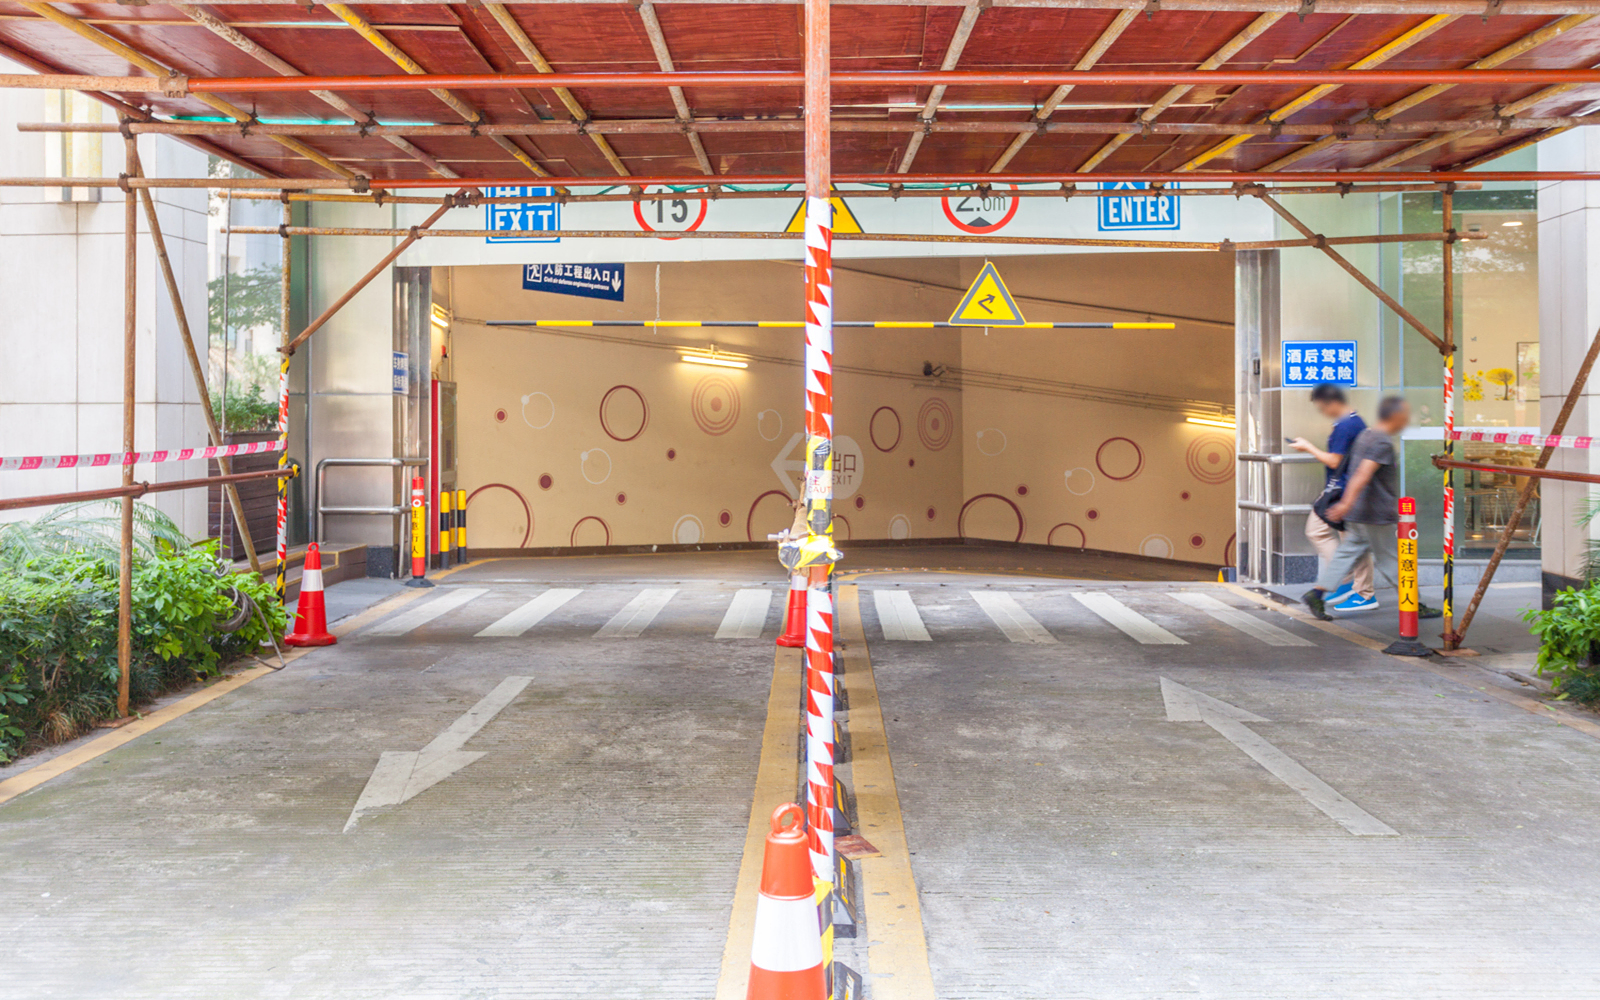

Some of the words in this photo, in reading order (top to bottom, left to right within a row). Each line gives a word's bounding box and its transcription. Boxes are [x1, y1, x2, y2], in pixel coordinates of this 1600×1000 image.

[650, 188, 688, 223] 15
[1108, 195, 1171, 223] ENTER
[494, 210, 553, 231] EXIT
[544, 263, 610, 282] 人防工程出入口
[1286, 348, 1353, 364] 酒后驾驶
[1288, 365, 1352, 381] 易发危险
[1401, 542, 1415, 606] 注意行人
